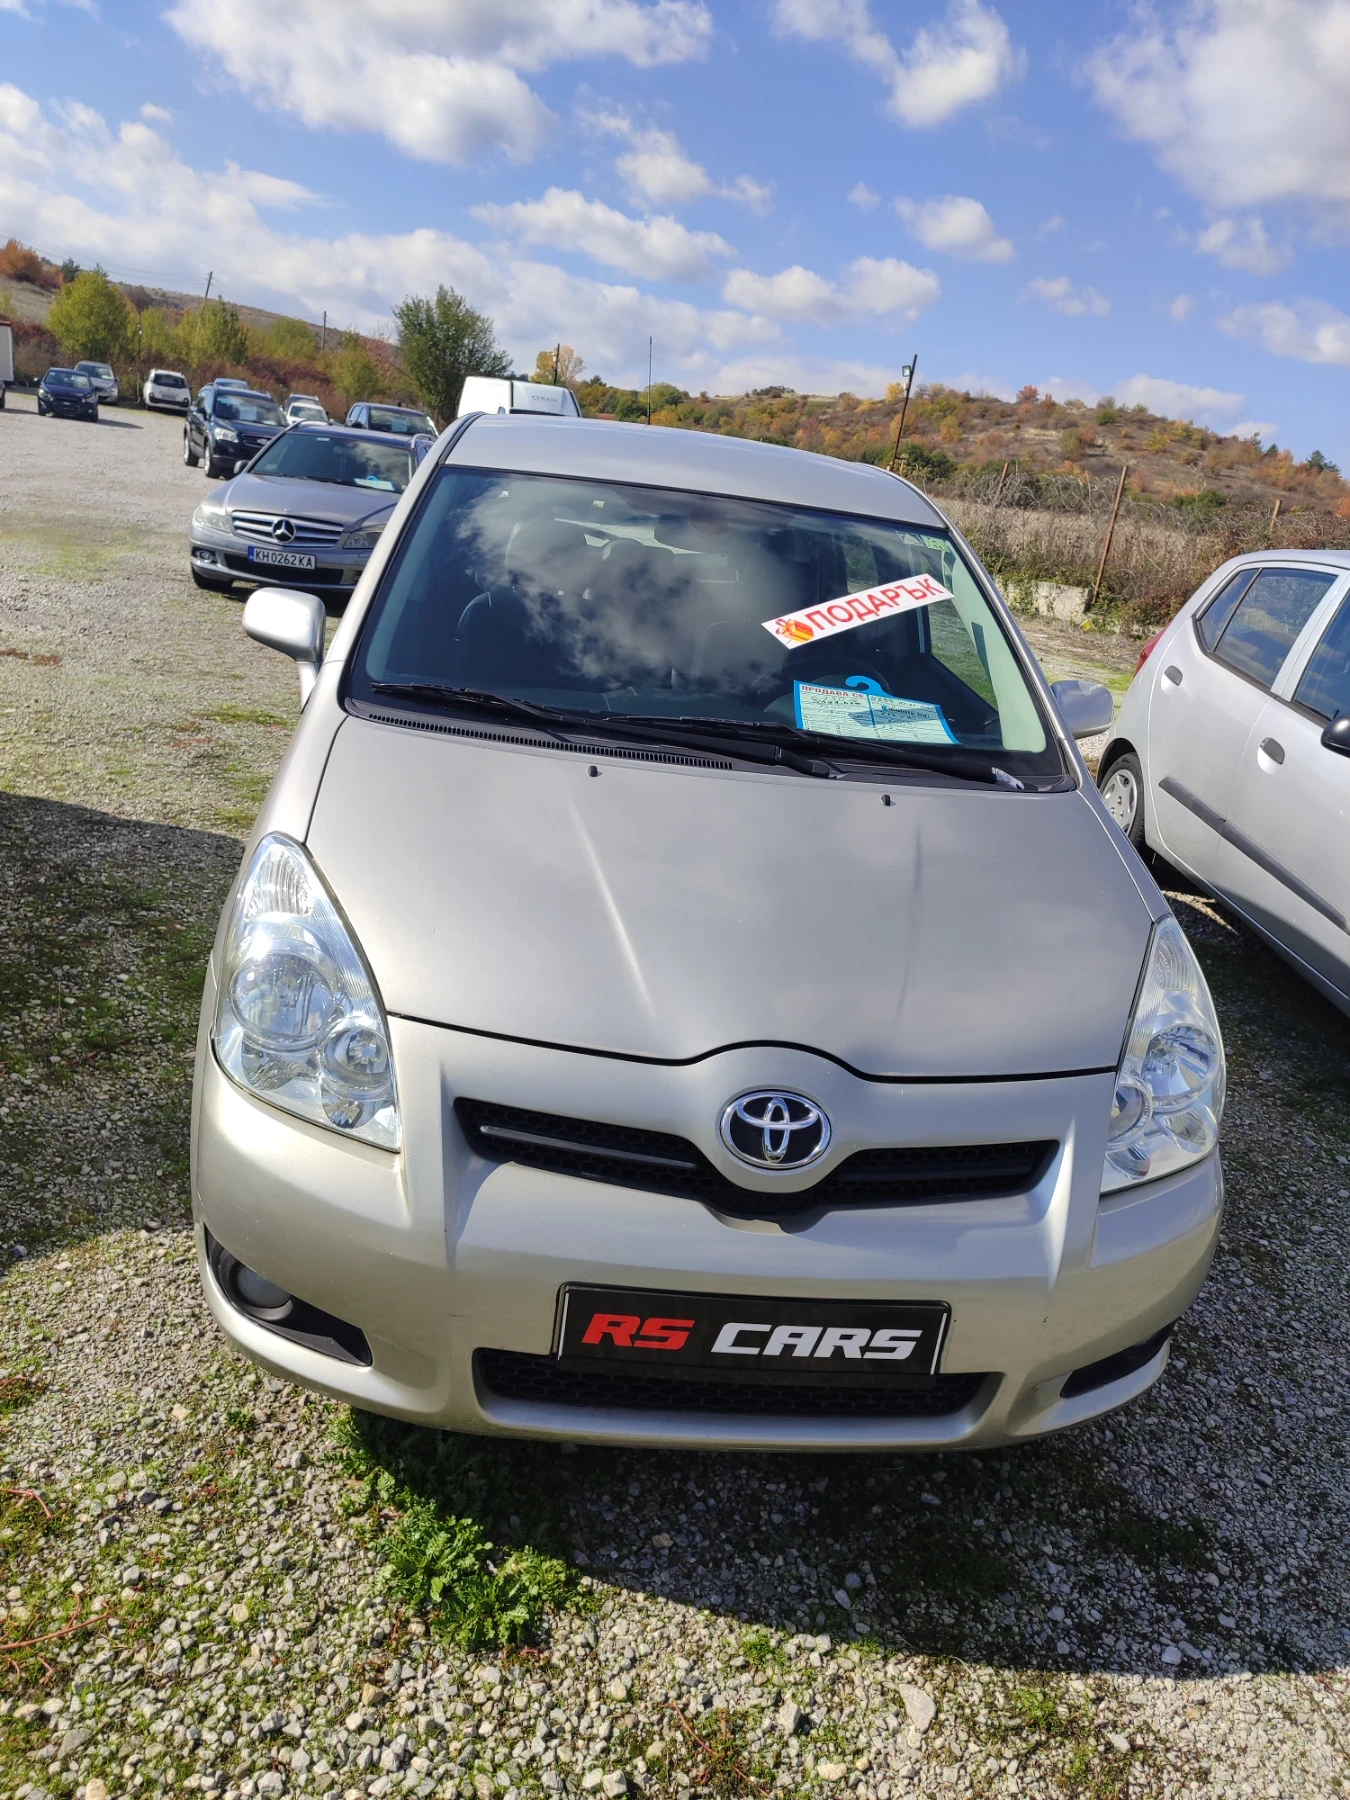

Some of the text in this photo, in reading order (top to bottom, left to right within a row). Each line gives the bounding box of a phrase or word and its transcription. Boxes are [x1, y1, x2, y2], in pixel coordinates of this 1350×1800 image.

[255, 549, 313, 568] KH0262KA
[804, 577, 945, 631] ПОДАРЪК
[801, 685, 849, 697] ПРОДАВА
[581, 1313, 924, 1360] RS CARS
